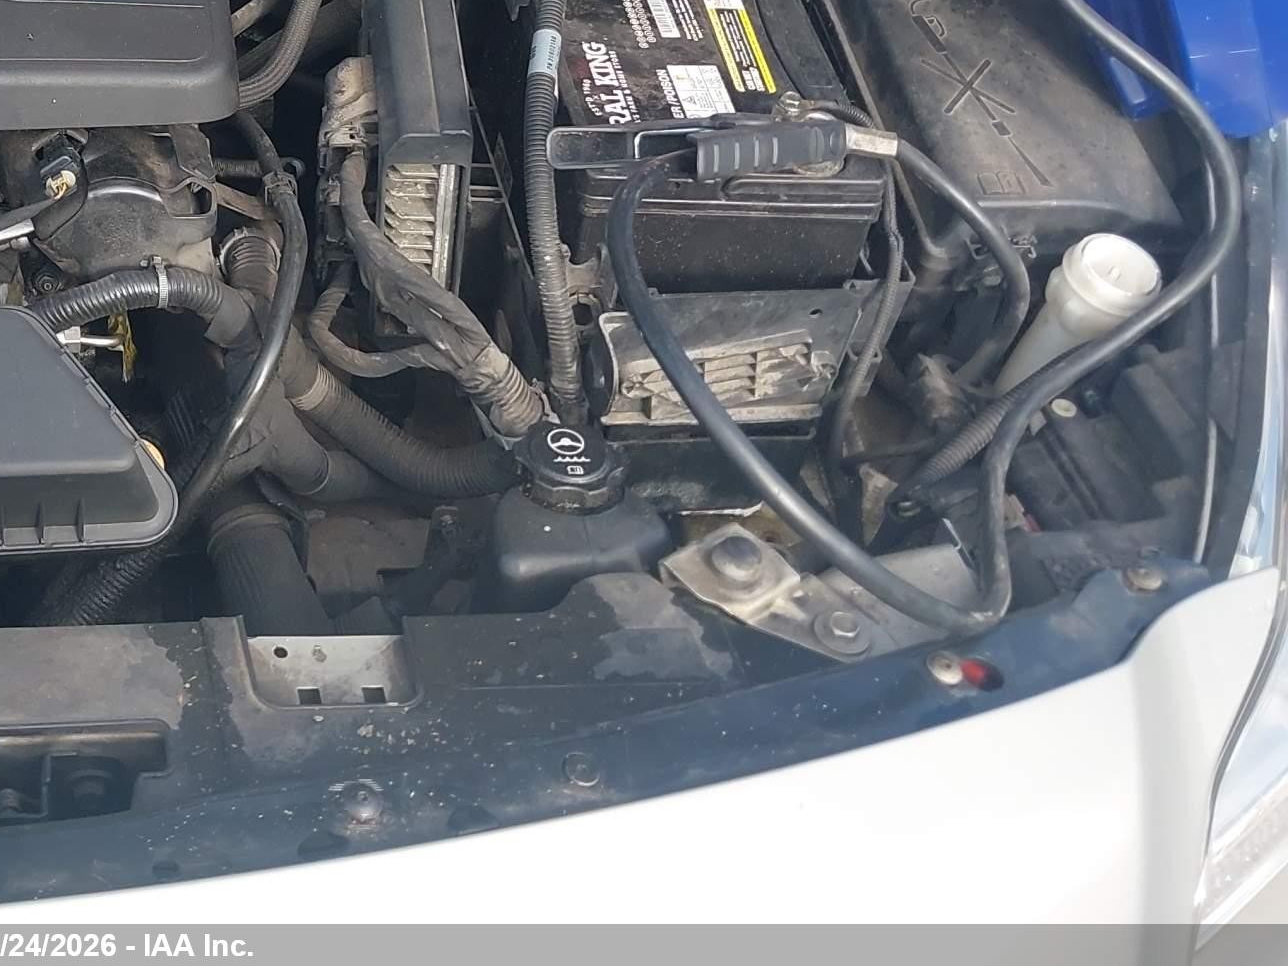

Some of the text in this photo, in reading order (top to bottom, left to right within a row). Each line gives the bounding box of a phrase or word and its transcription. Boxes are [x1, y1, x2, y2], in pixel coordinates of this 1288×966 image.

[581, 41, 632, 125] RAL KING
[656, 69, 685, 119] ER/POISON
